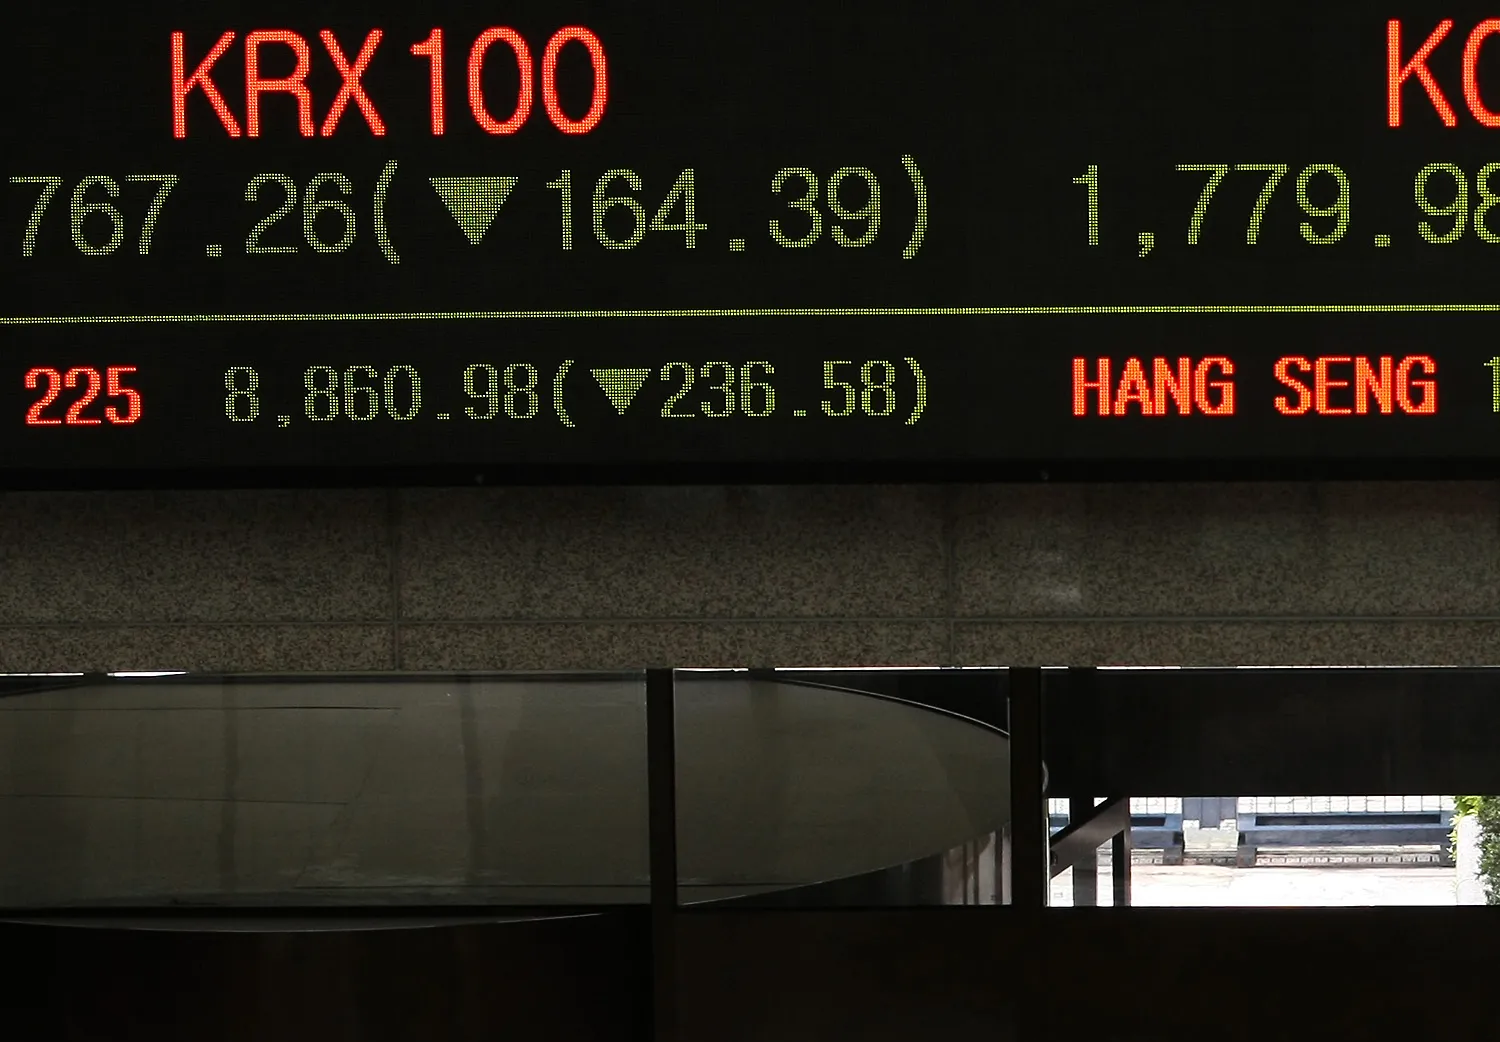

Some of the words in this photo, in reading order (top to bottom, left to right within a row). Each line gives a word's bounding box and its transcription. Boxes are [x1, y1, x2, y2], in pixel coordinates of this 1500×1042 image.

[24, 365, 143, 426] 225
[1072, 355, 1220, 417] HANG
[1273, 354, 1438, 416] SENG
